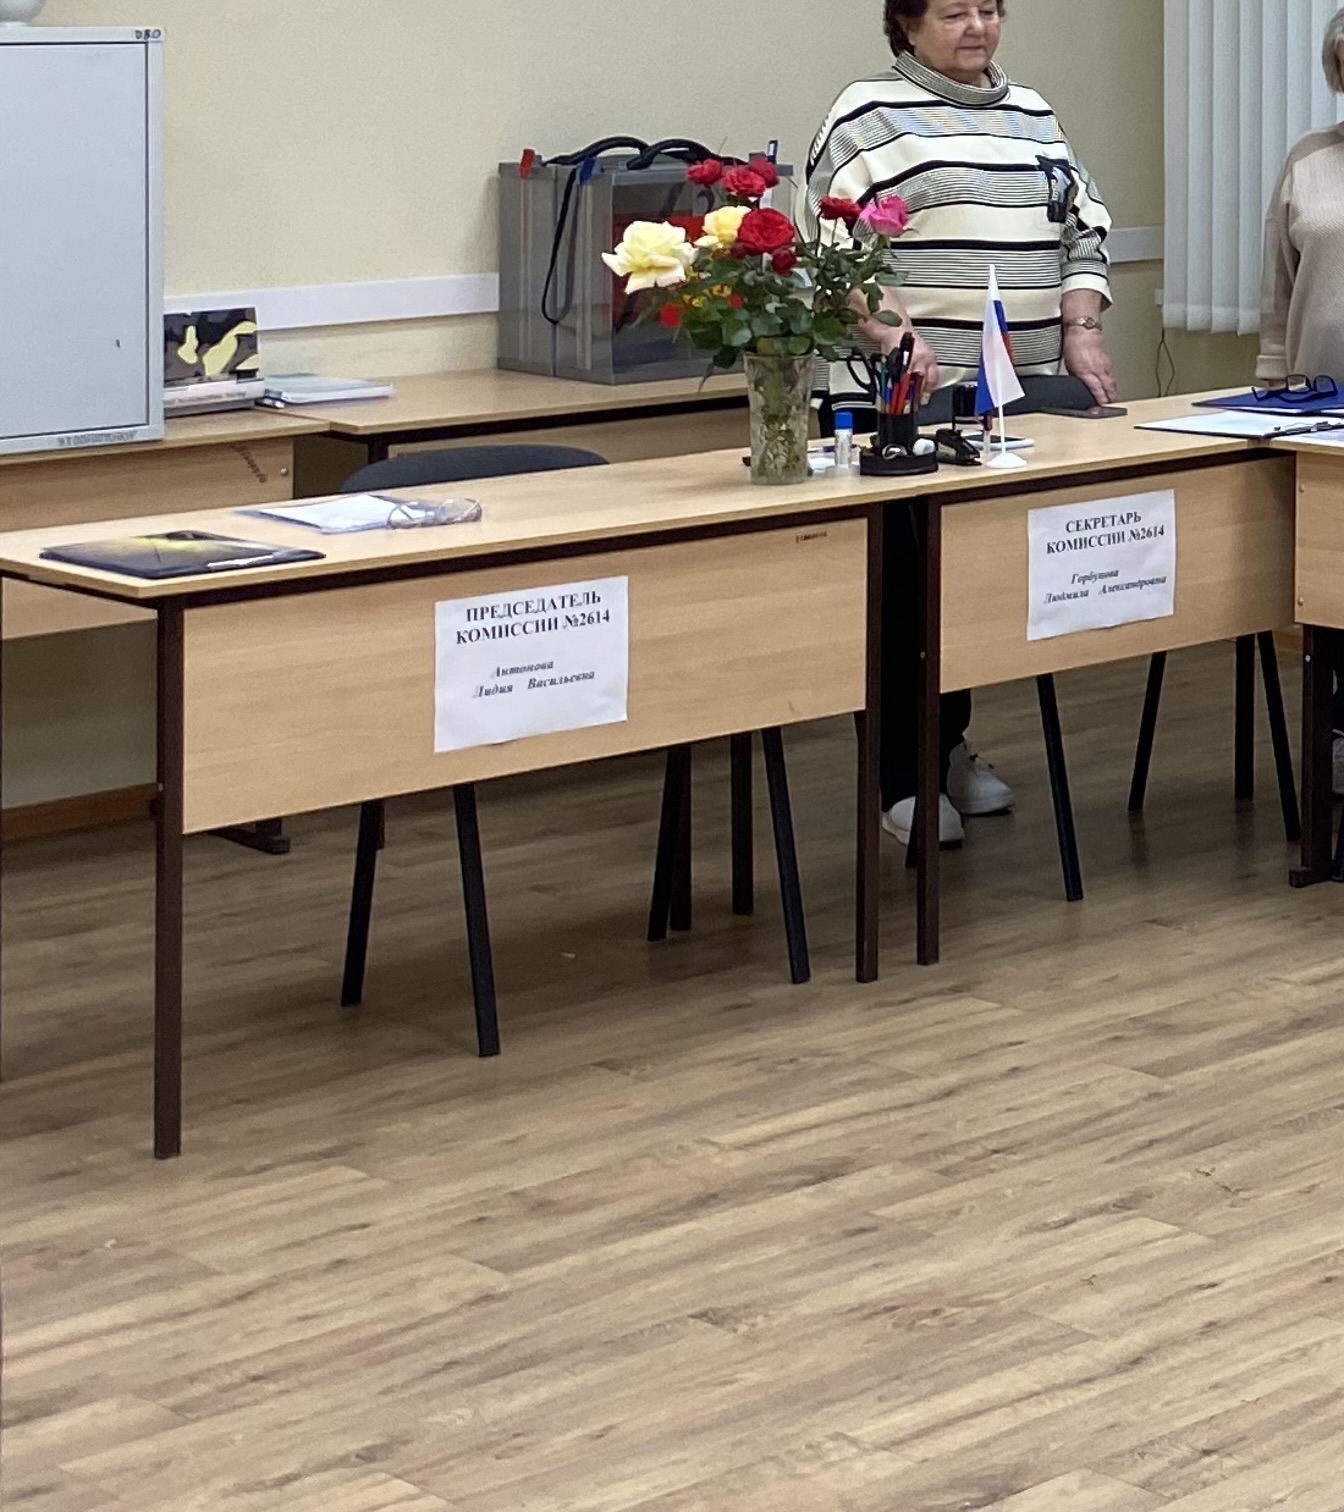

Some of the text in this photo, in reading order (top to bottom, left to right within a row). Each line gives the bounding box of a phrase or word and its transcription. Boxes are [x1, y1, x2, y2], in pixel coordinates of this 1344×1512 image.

[1065, 511, 1142, 533] СЕКРЕТАРЬ
[1046, 524, 1165, 555] КОМИССИИ №2614
[466, 590, 601, 621] ПРЕДСЕДАТЕЛЬ
[456, 609, 611, 645] КОМИССИИ №2614
[473, 669, 596, 699] Лидия Васильевна
[491, 659, 555, 679] Антонова
